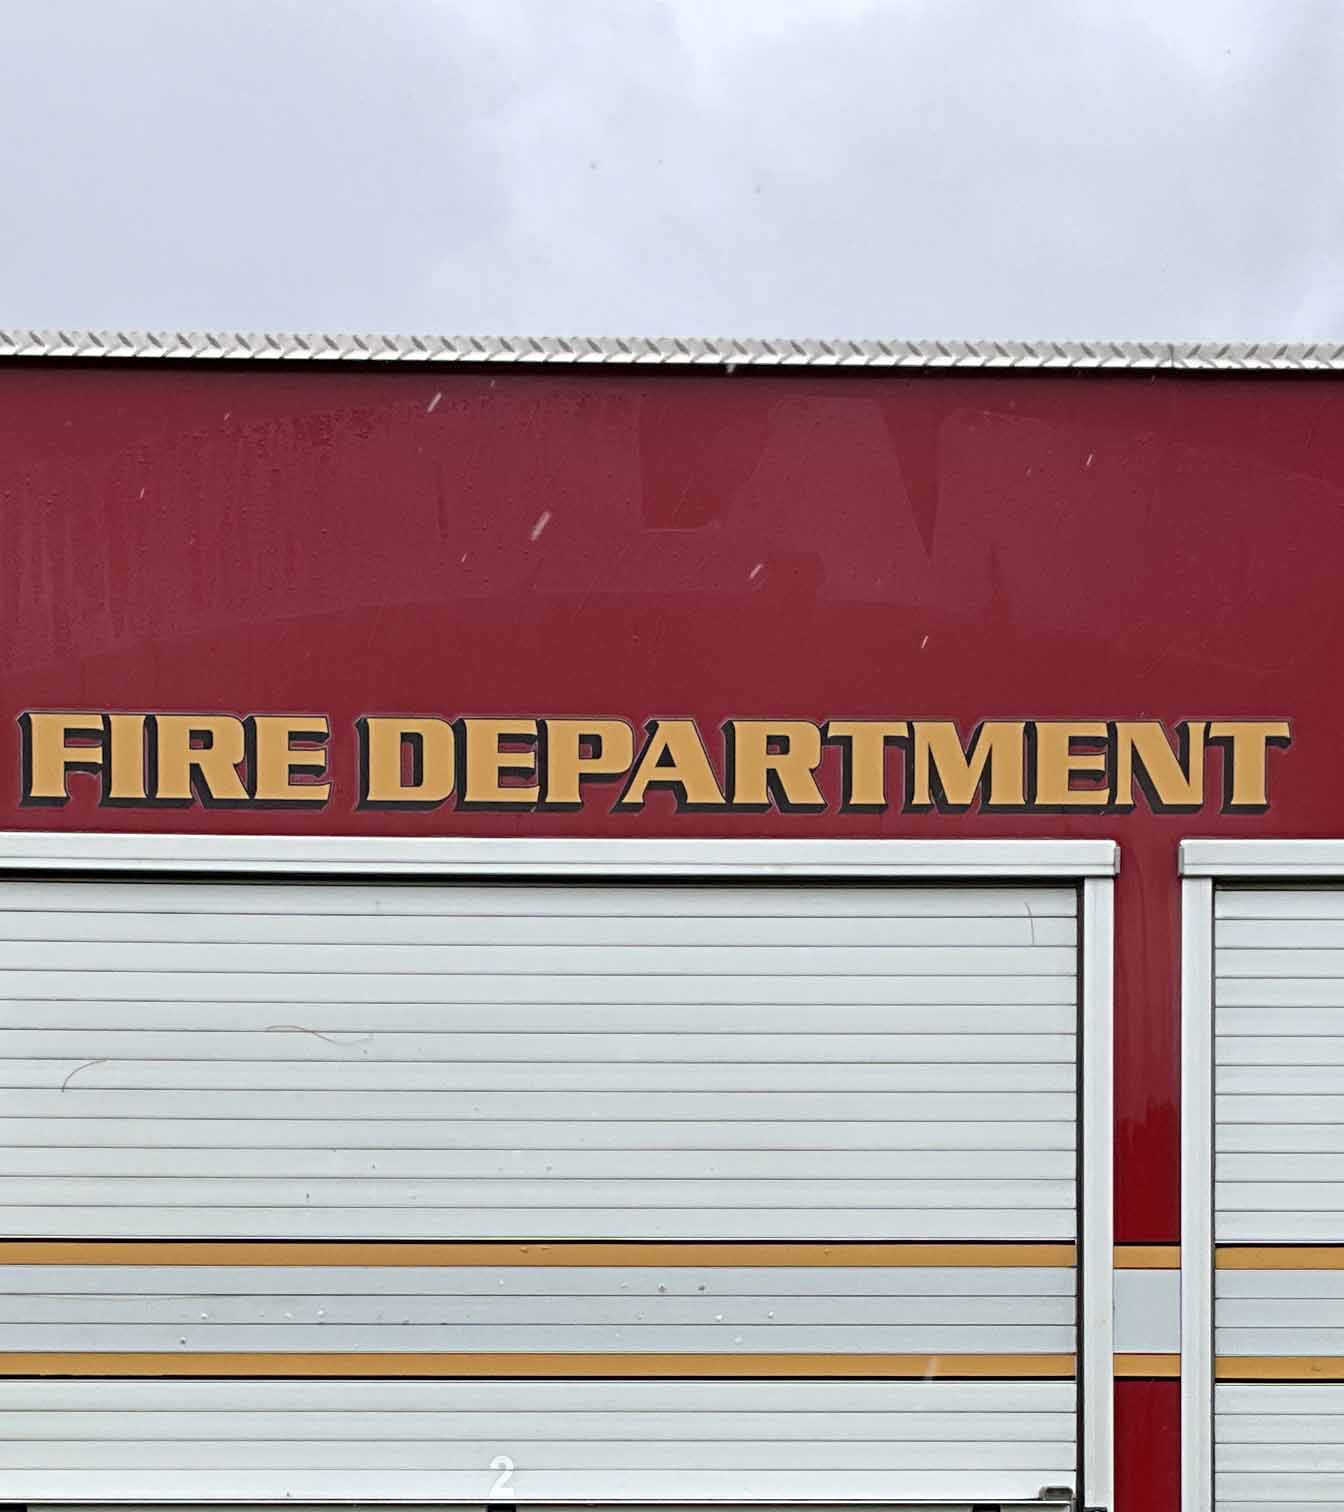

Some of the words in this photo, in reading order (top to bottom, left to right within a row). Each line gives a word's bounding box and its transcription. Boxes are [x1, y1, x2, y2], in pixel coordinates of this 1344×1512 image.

[19, 712, 331, 808] FIRE
[355, 715, 1293, 817] DEPARTMENT
[489, 1455, 514, 1497] 2
